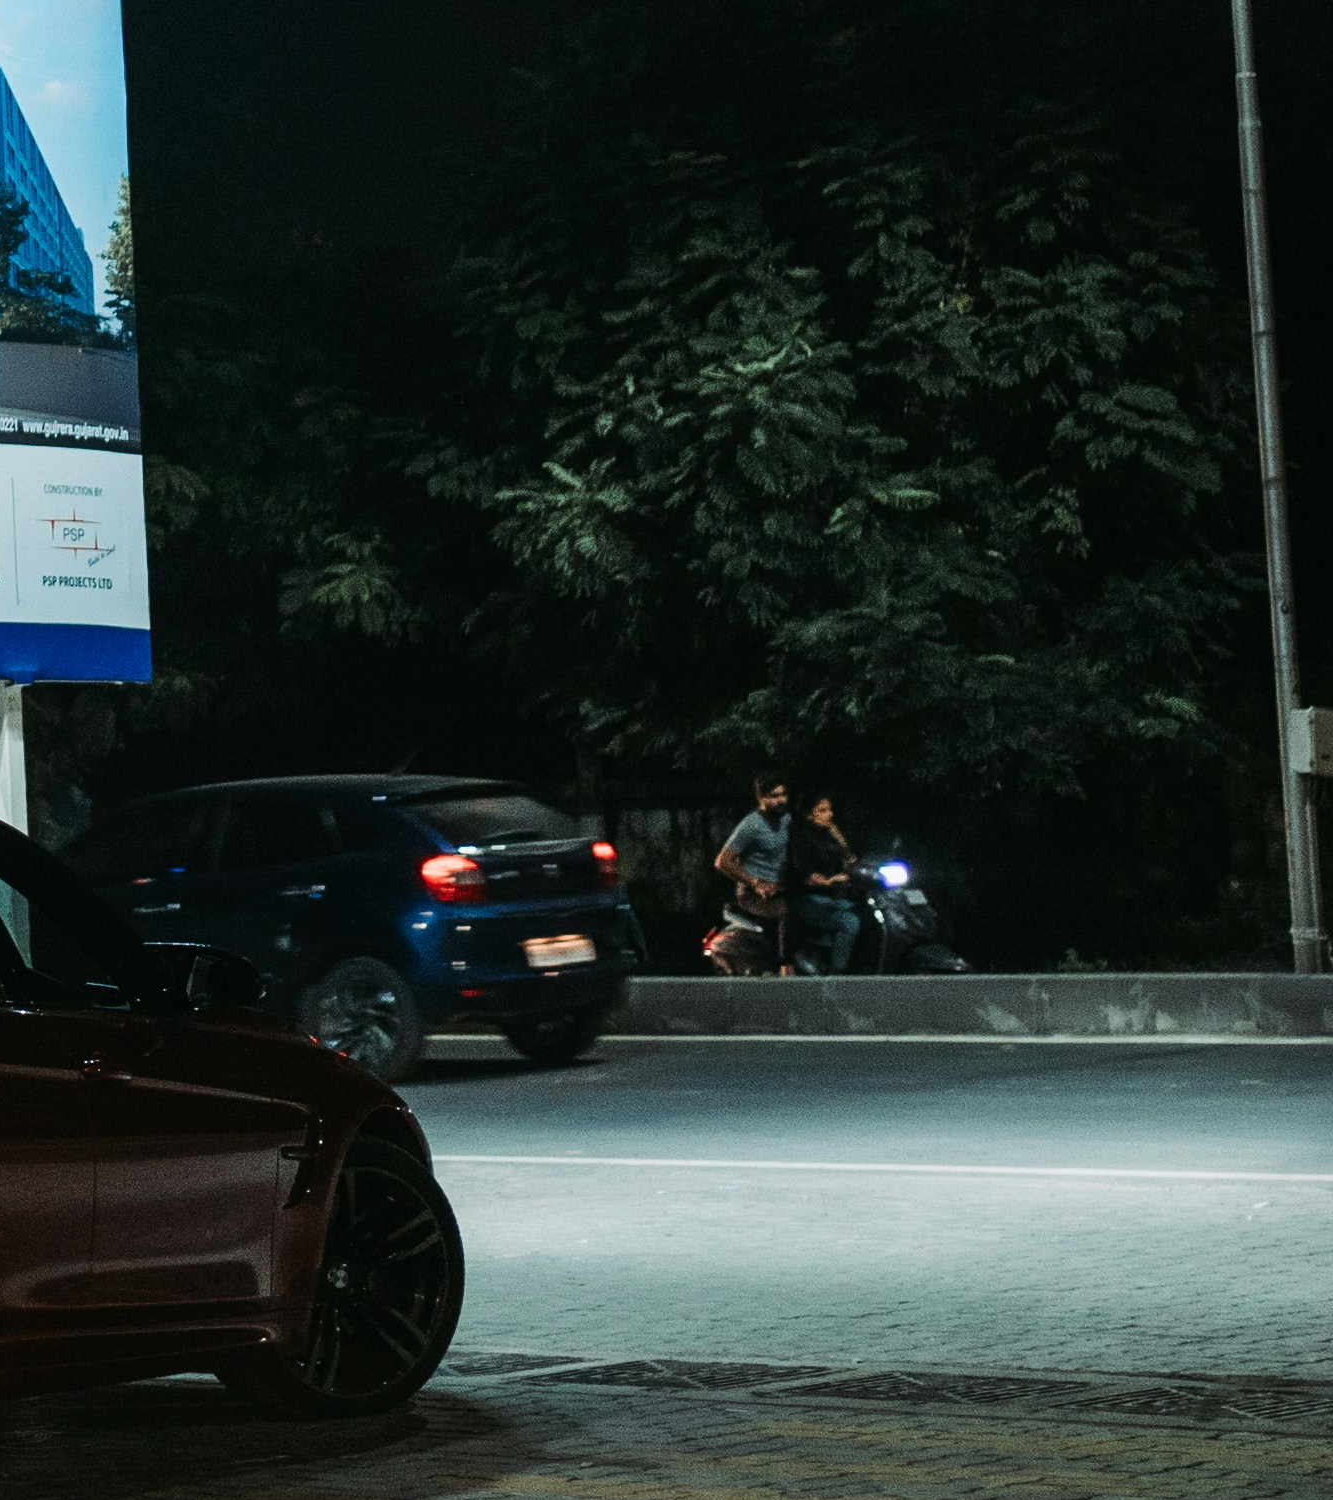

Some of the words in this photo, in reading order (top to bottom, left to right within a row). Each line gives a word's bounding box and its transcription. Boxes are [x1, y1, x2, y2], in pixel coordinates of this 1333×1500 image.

[43, 484, 93, 496] CONSTRUCTION
[62, 527, 85, 542] PSP
[42, 575, 58, 588] PSP
[58, 576, 97, 589] PROJECTS
[97, 577, 113, 590] LTD
